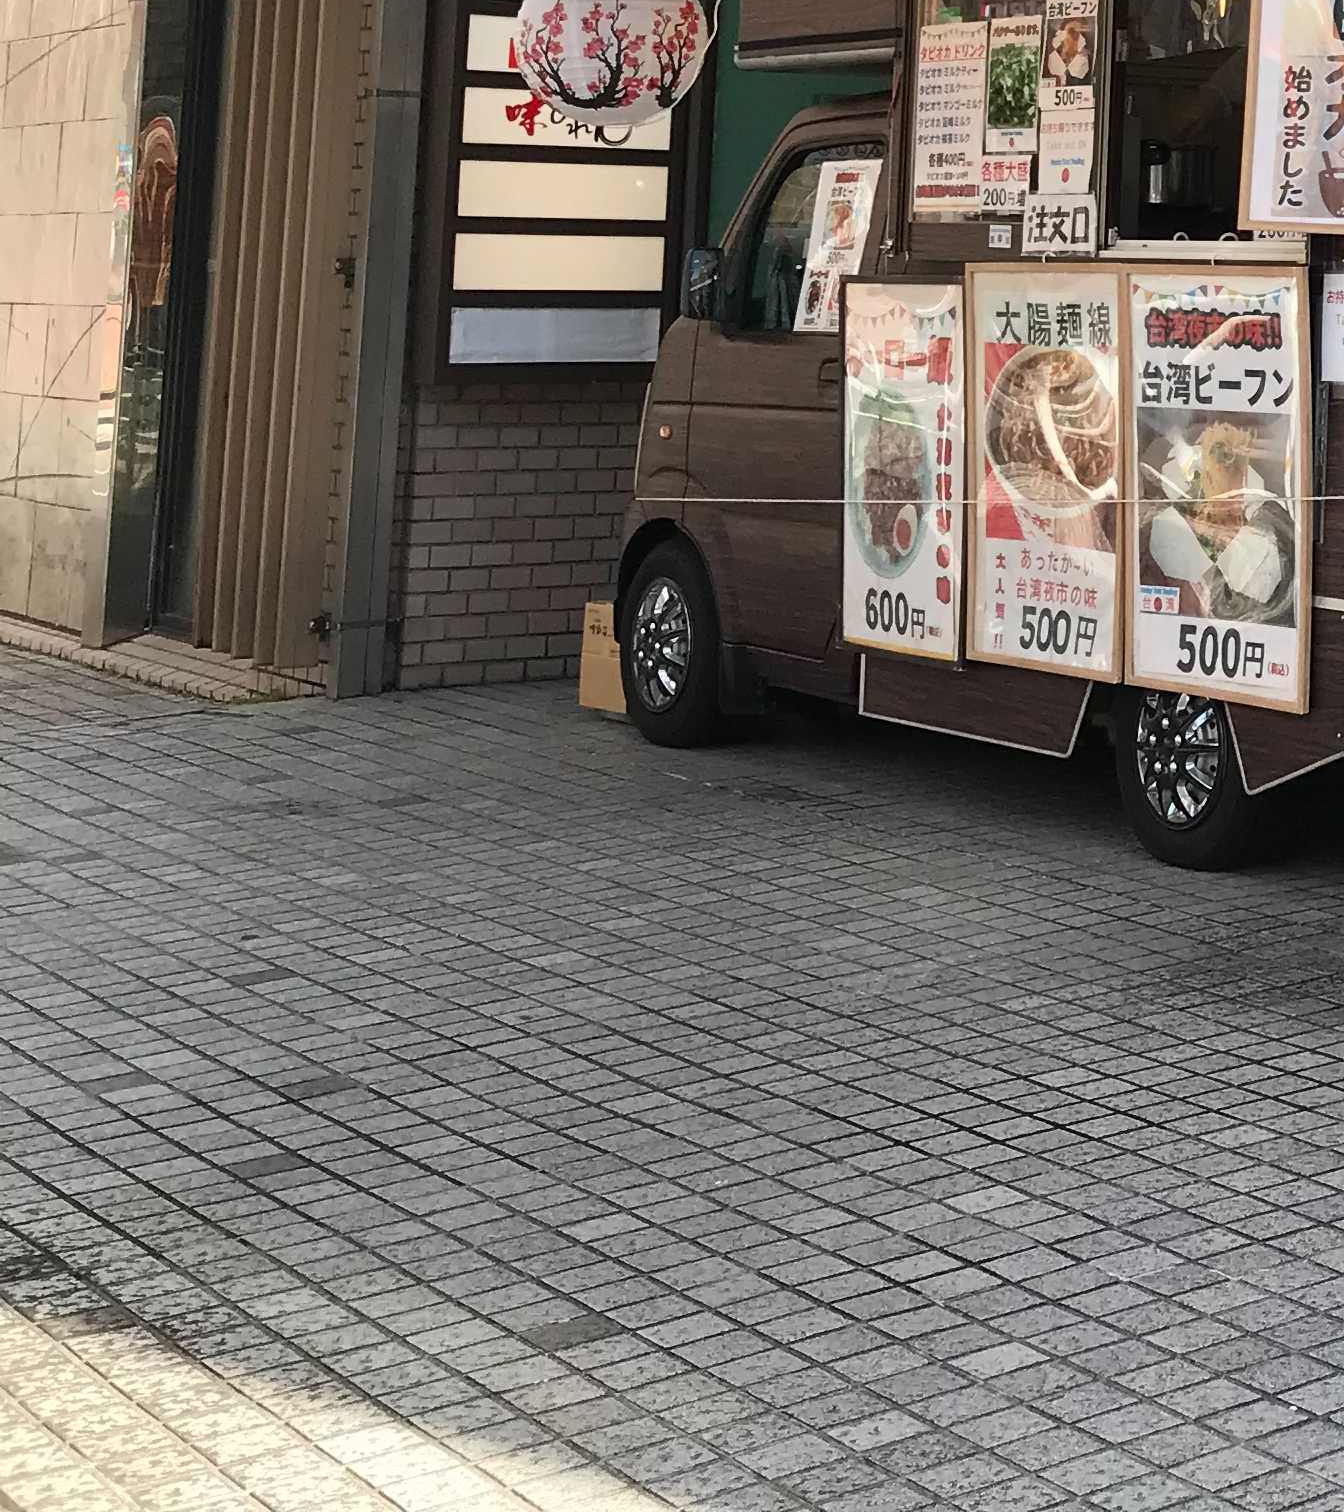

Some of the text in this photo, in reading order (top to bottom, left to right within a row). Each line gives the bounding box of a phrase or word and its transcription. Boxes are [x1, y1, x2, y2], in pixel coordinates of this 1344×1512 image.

[954, 44, 986, 58] ドリンク
[1053, 88, 1083, 106] 500円
[1278, 64, 1314, 208] 始めました
[1027, 204, 1090, 244] 注文口
[1139, 359, 1295, 408] 台湾ビーフン
[865, 587, 926, 639] 600円
[1016, 575, 1098, 609] 台湾夜市の味
[1018, 603, 1099, 659] 500円
[1177, 623, 1265, 678] 500円
